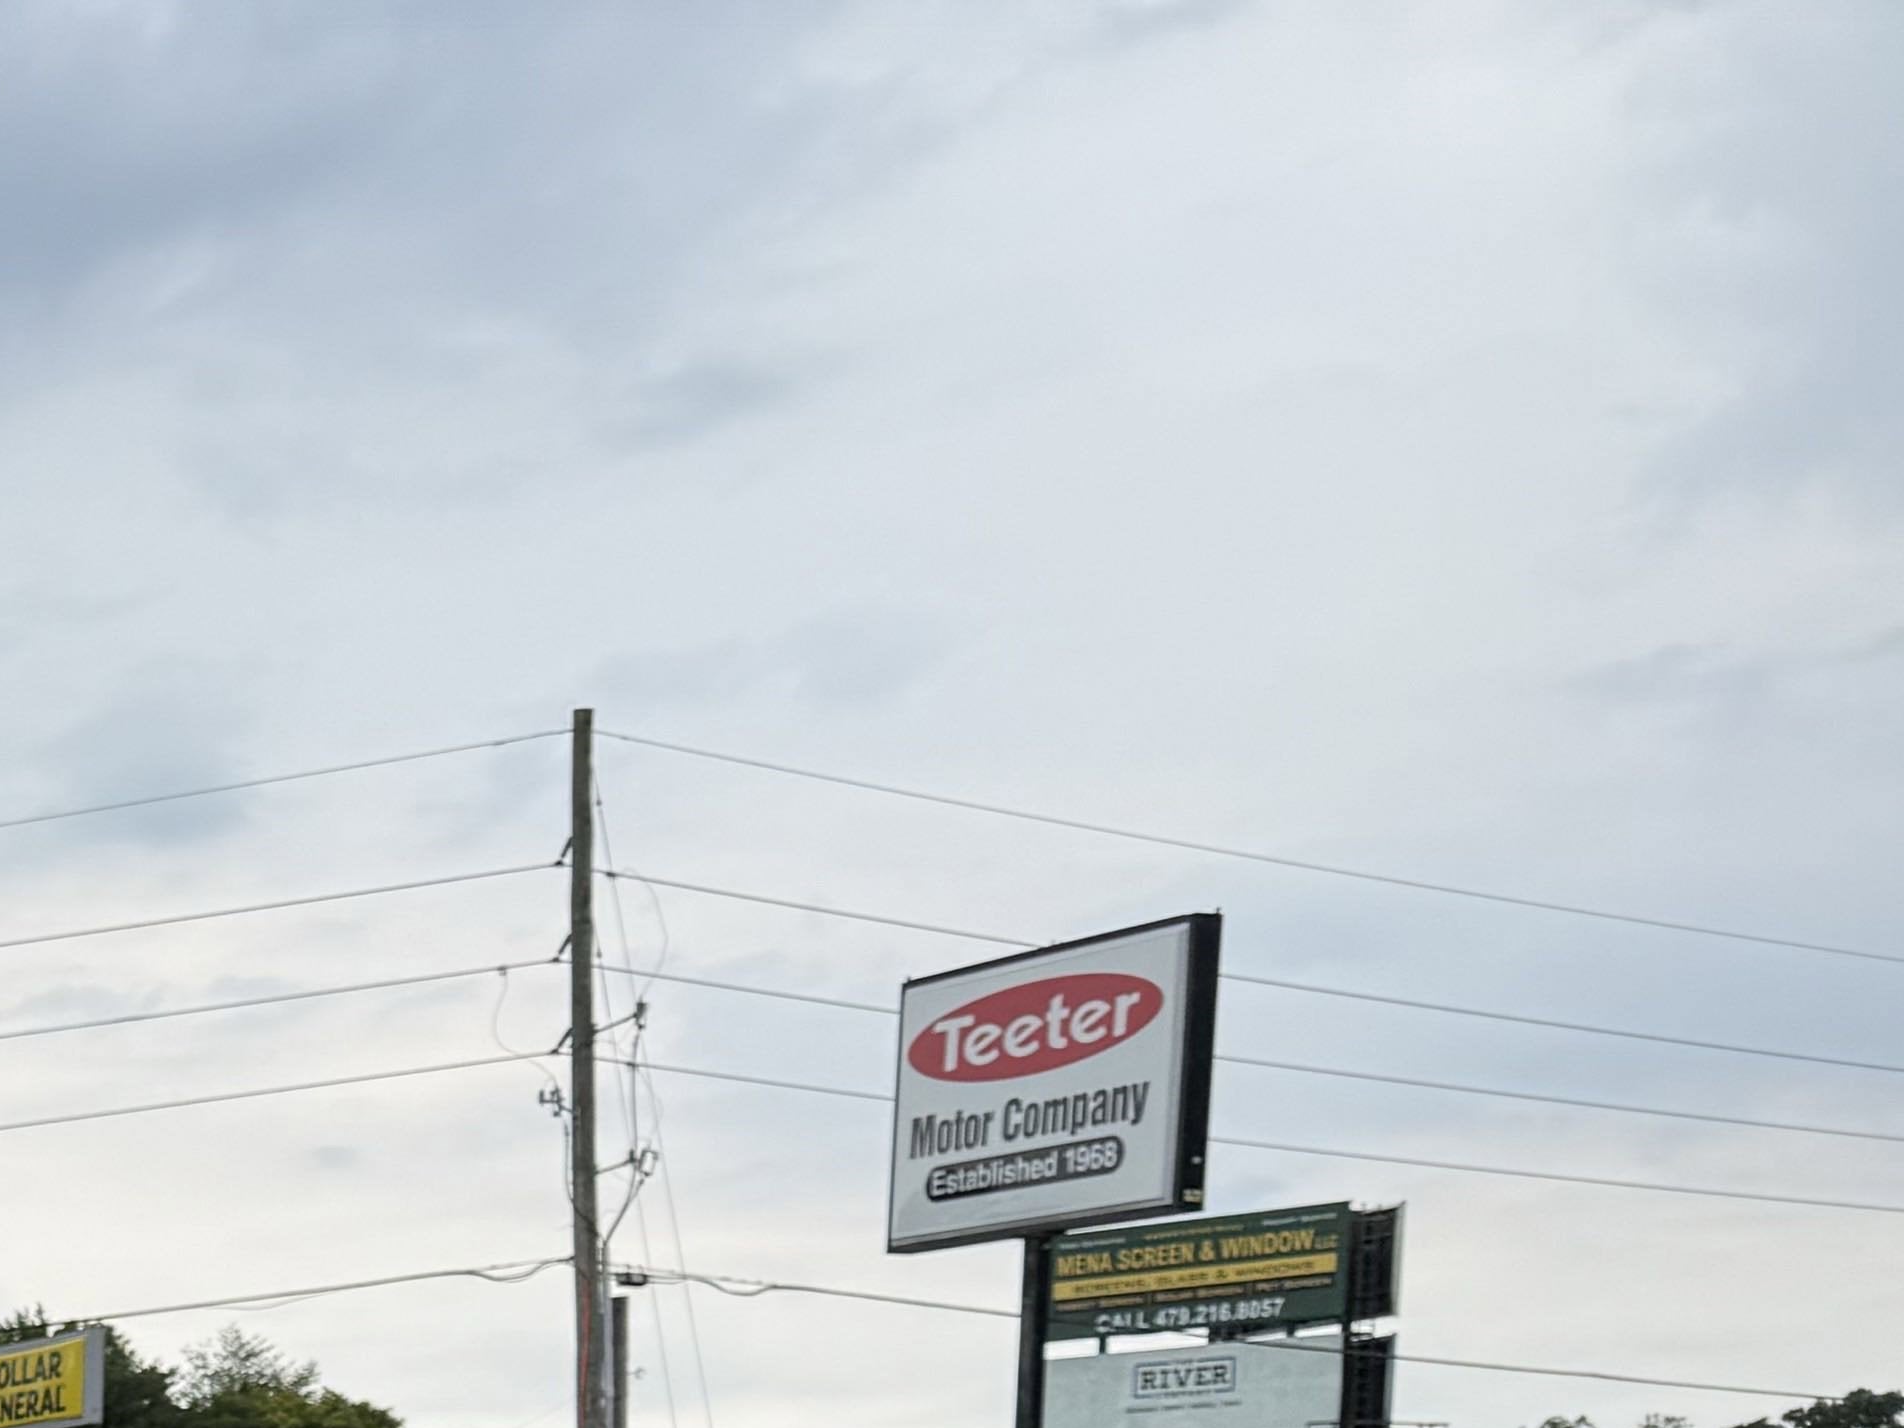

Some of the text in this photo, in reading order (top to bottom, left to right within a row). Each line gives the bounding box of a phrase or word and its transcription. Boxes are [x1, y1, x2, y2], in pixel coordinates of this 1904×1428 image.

[932, 992, 1141, 1072] Teeter
[910, 1081, 1151, 1159] Motor Company
[929, 1142, 1118, 1197] Established 1968
[1056, 1252, 1114, 1276] MENA
[1117, 1242, 1195, 1271] SCREEN
[1198, 1239, 1214, 1261] &
[1218, 1229, 1315, 1258] WINDOW
[1139, 1364, 1229, 1390] RIVER
